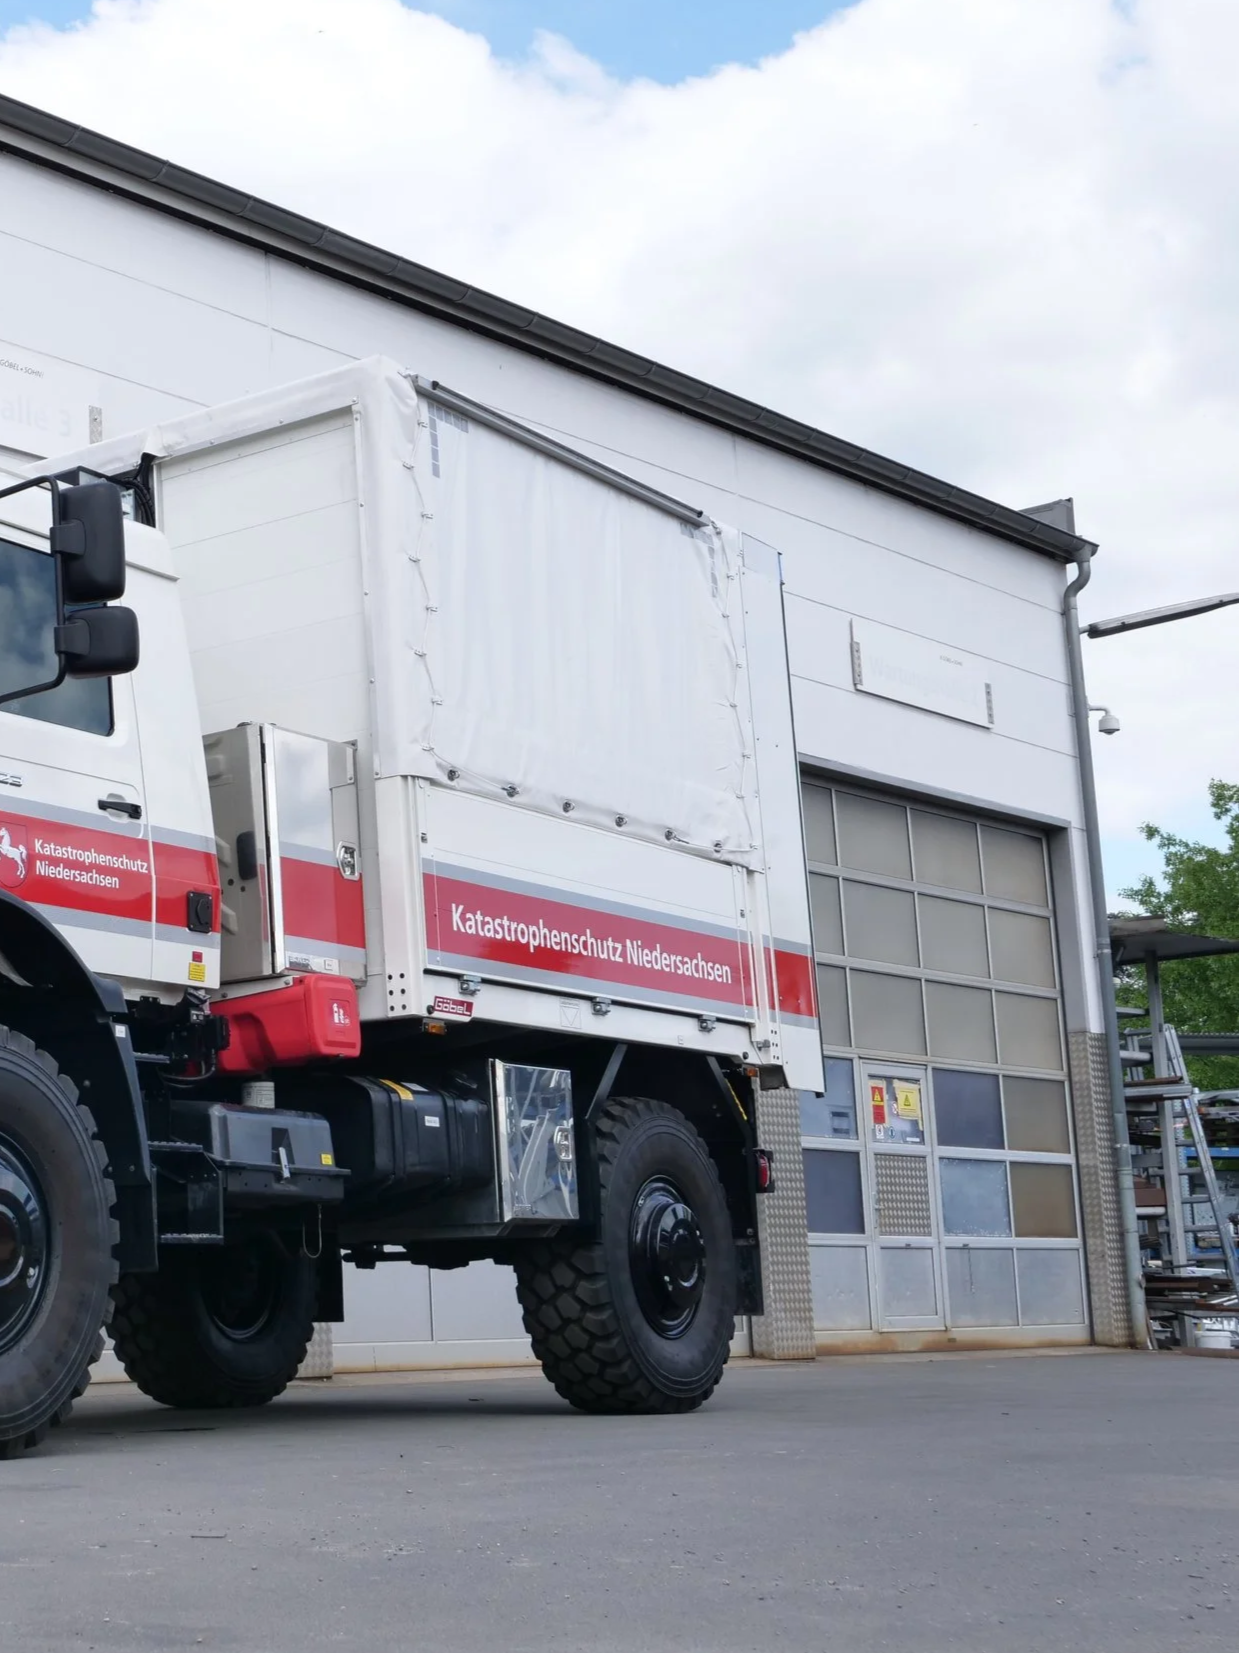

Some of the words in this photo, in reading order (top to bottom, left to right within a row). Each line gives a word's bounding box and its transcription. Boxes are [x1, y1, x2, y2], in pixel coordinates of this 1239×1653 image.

[35, 838, 148, 873] Katastrophenschutz
[36, 859, 119, 889] Niedersachsen
[451, 903, 623, 963] Katastrophenschutz
[626, 939, 731, 984] Niedersachsen
